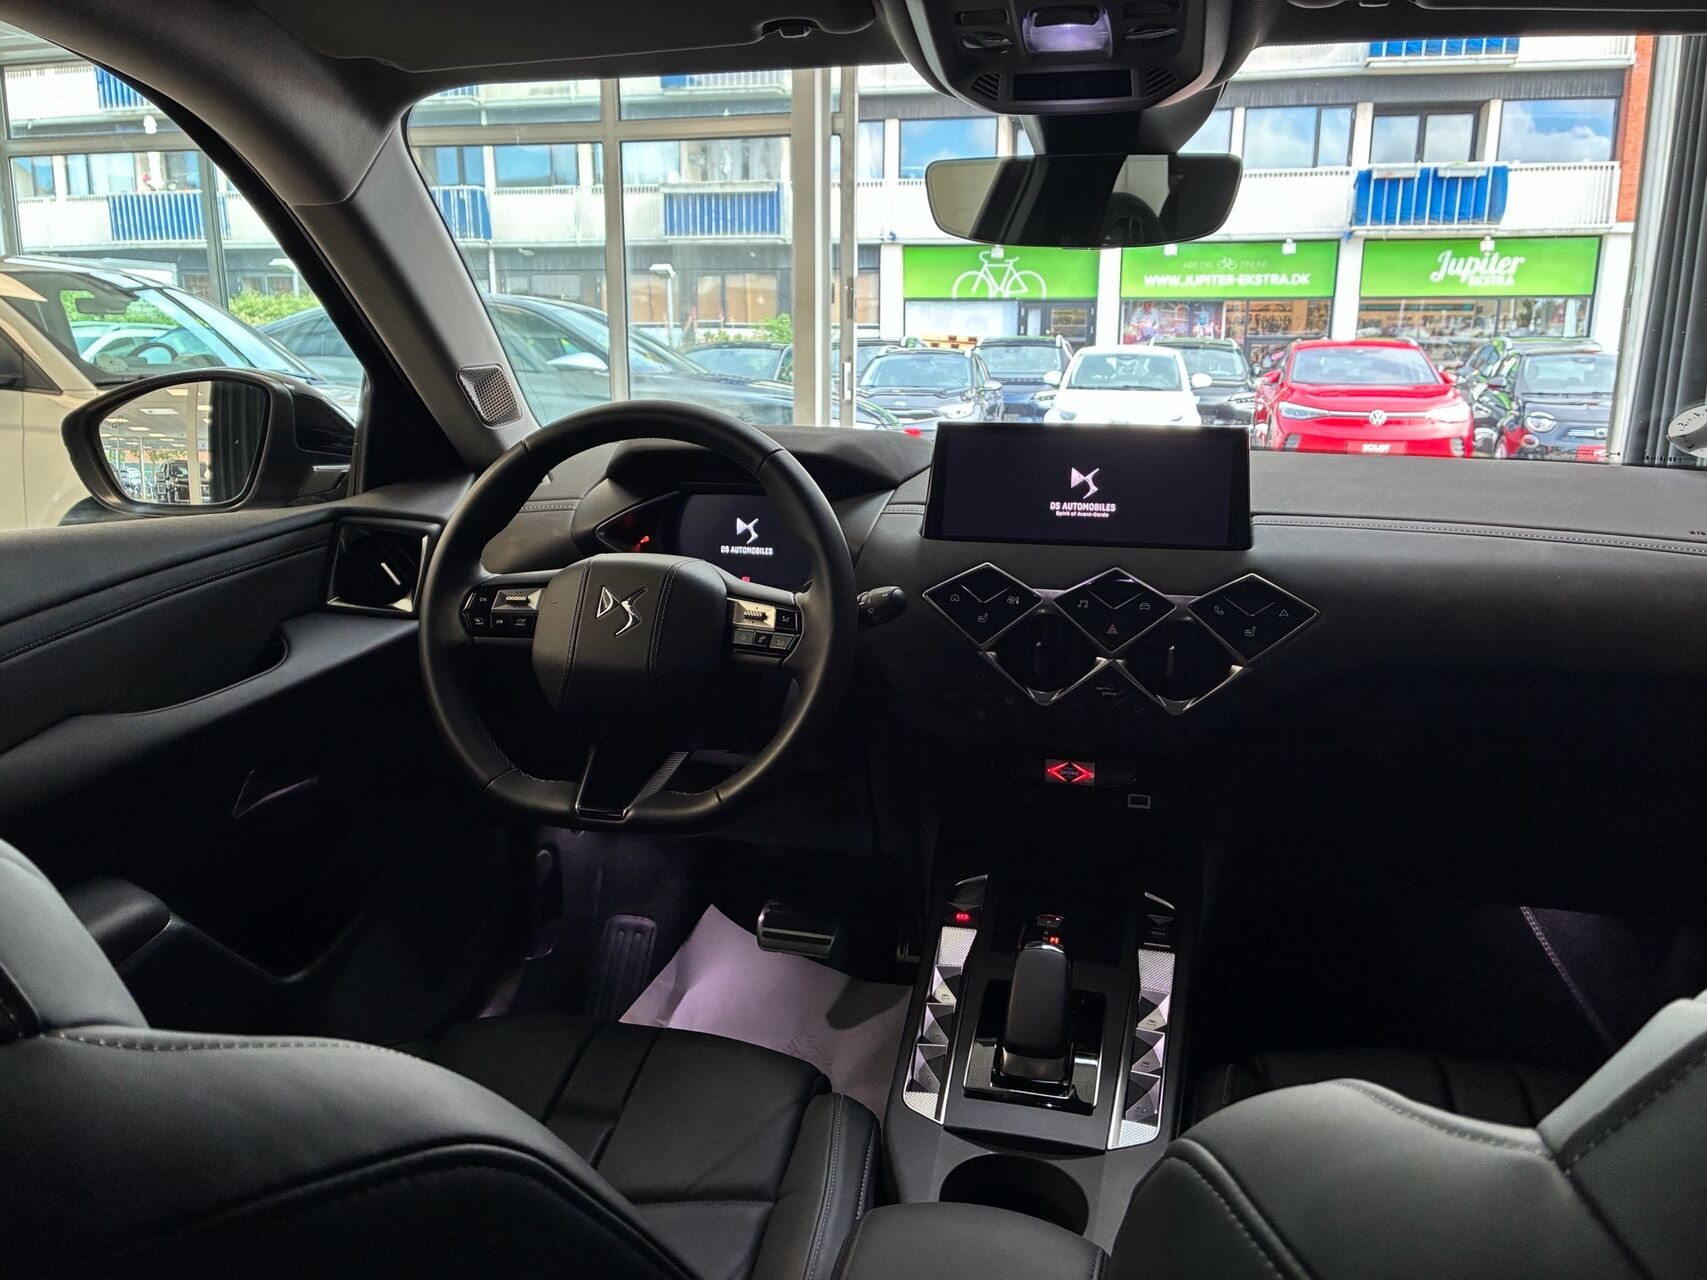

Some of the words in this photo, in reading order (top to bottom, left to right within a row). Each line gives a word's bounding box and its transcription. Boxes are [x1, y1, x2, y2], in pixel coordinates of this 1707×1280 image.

[1430, 250, 1526, 283] Jupiter
[1144, 273, 1310, 287] WWW.JUPITER-EKSTRA.DK
[1050, 501, 1061, 510] DS
[1062, 502, 1117, 512] AUTOMOBILES
[720, 545, 730, 554] DS
[730, 546, 774, 556] AUTOMOBILES
